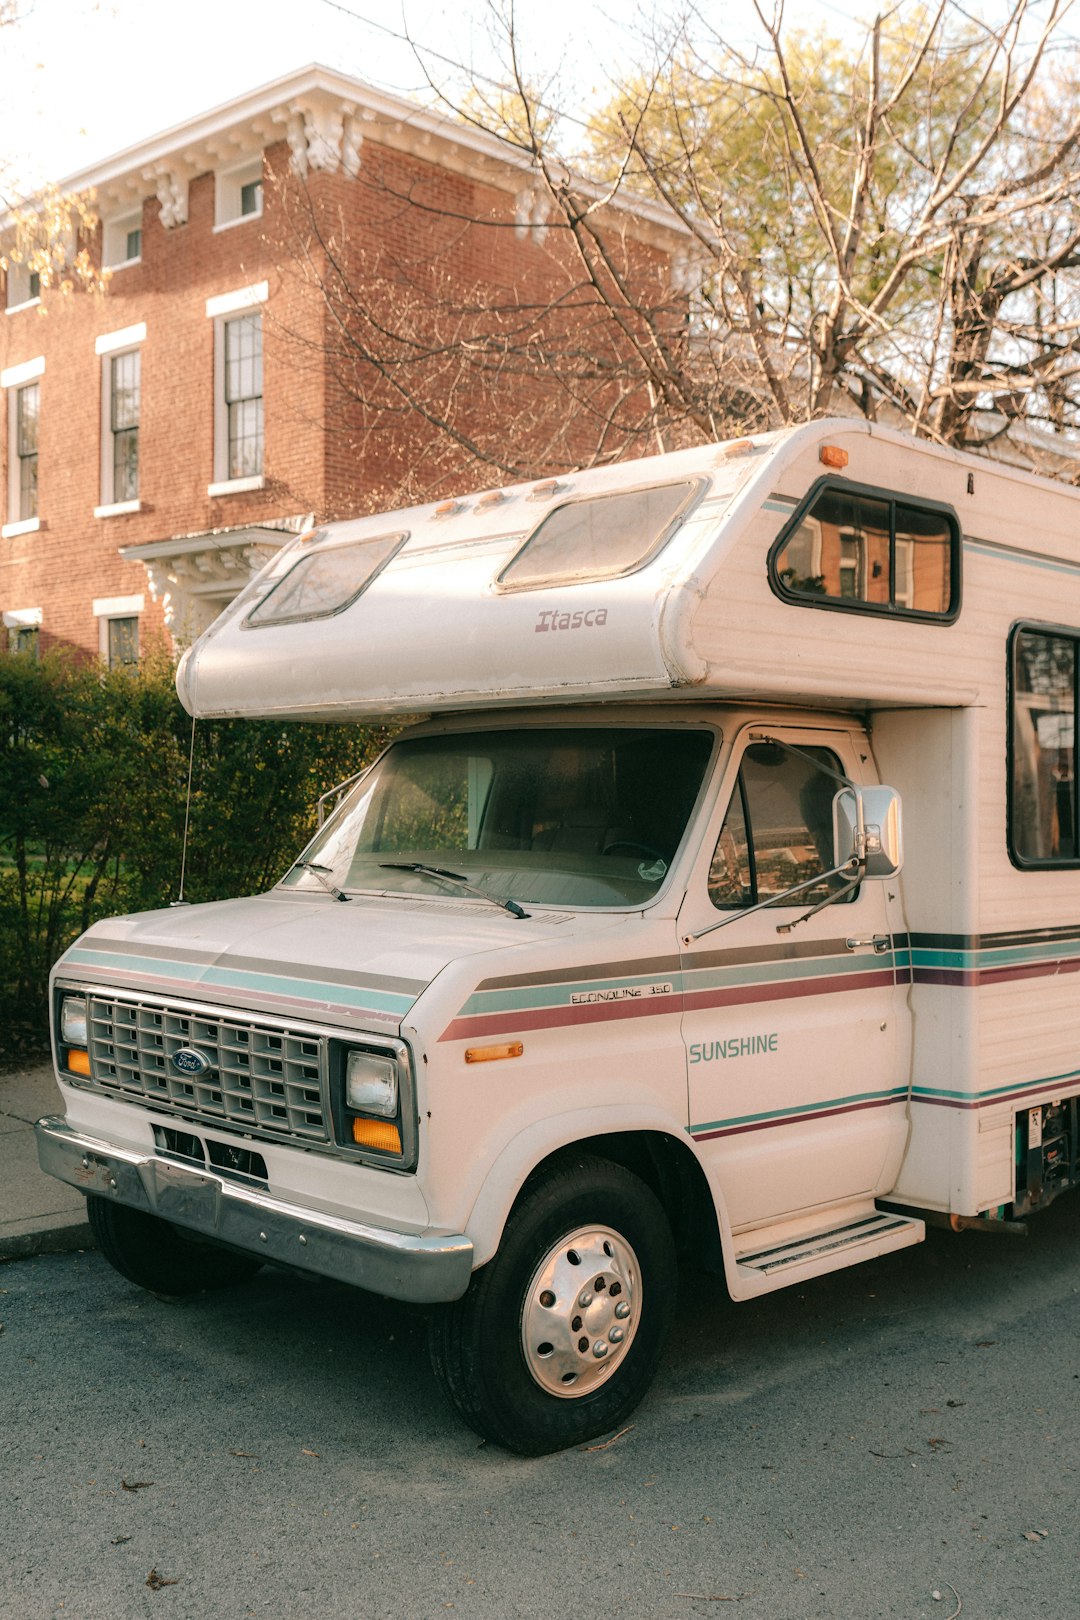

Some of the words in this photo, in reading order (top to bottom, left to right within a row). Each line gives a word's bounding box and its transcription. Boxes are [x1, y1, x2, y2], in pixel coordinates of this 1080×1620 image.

[535, 608, 608, 632] Itasca
[648, 984, 671, 995] 350
[689, 1033, 778, 1064] SUNSHINE
[178, 1053, 197, 1069] Ford
